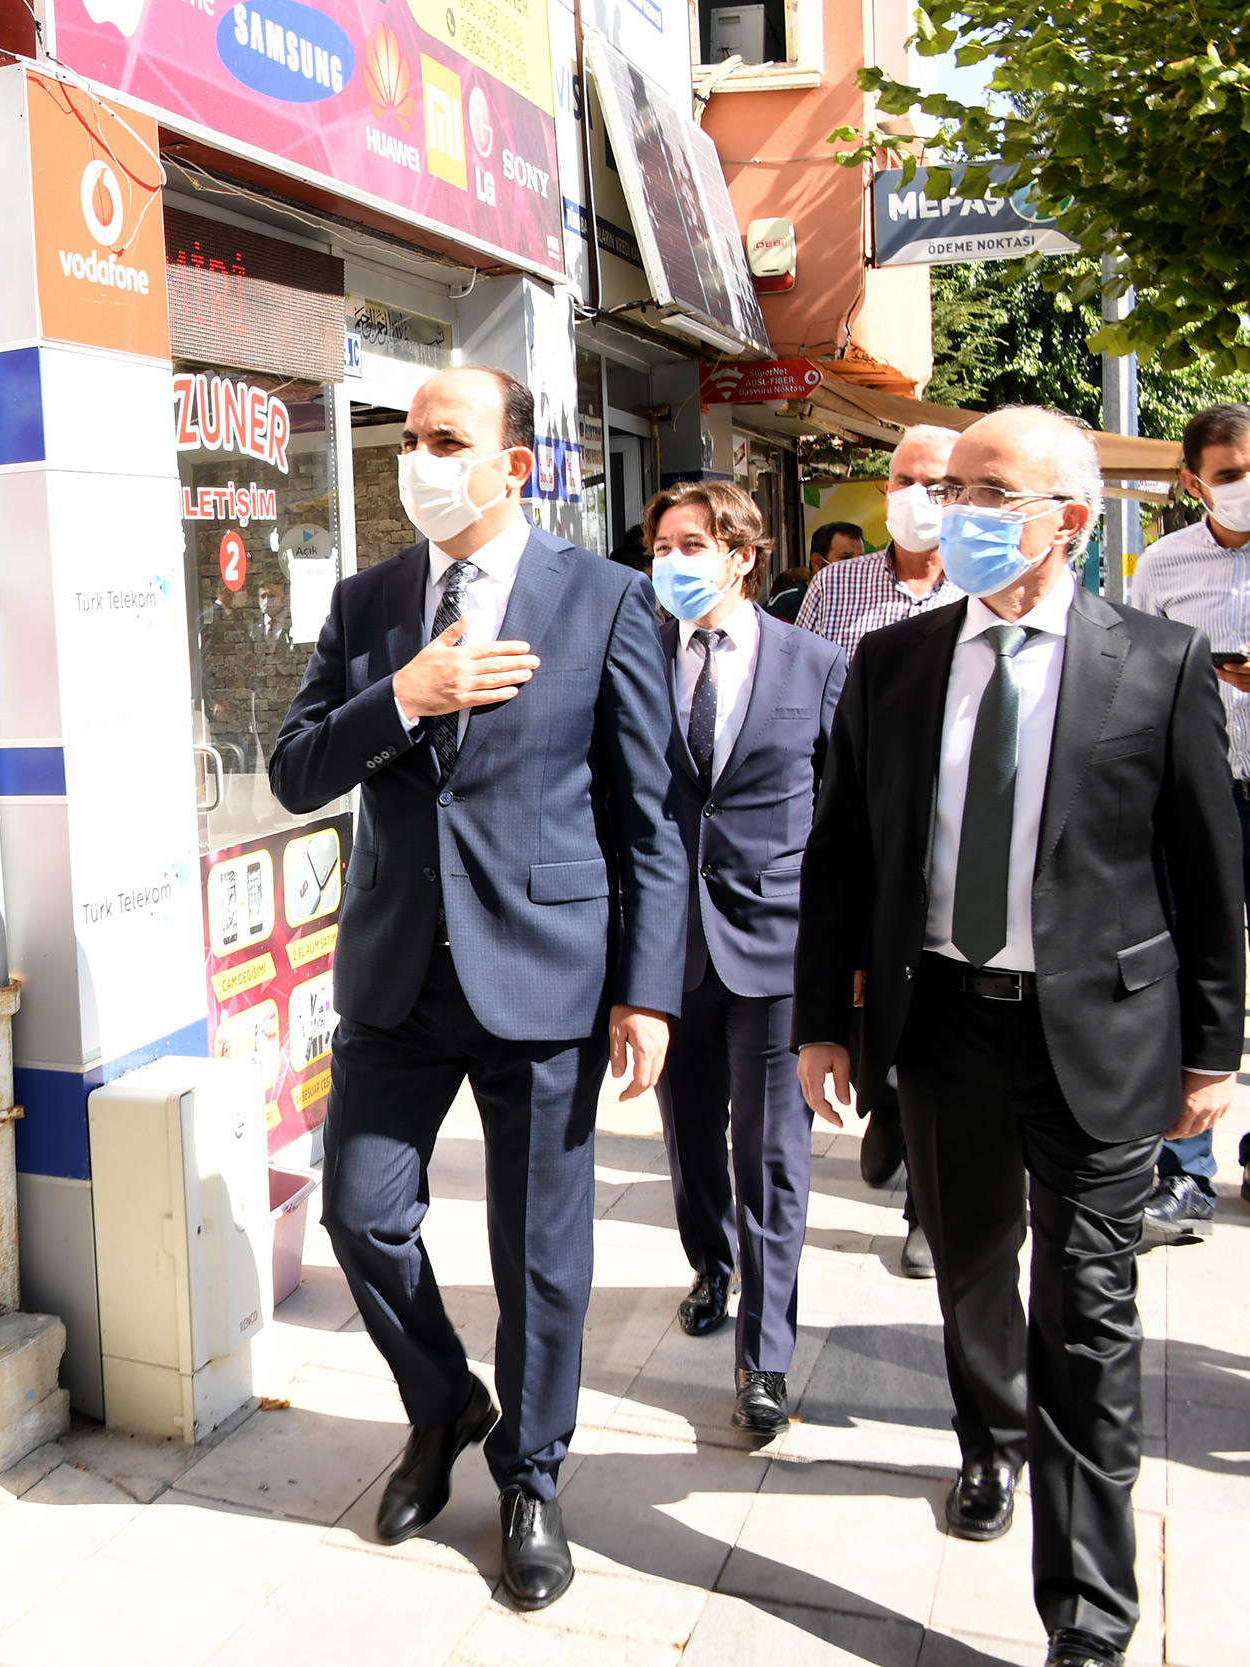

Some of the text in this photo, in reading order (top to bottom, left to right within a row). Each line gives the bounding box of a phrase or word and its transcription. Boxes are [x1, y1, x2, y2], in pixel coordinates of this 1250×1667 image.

[233, 2, 343, 94] SAMSUNG
[366, 126, 421, 173] HUAWEI
[475, 167, 496, 208] LG
[502, 149, 550, 199] SONY
[888, 183, 1005, 222] MEPAŞ
[927, 235, 1035, 255] ÖDEME NOKTASI
[59, 249, 149, 294] vodafone
[174, 374, 288, 474] ZUNER
[180, 482, 276, 526] LETİŞİM
[225, 541, 239, 581] 2
[295, 546, 318, 557] Açık
[76, 590, 156, 611] Türk Telekom
[82, 884, 172, 925] Türk Telekom
[221, 975, 238, 993] CAM
